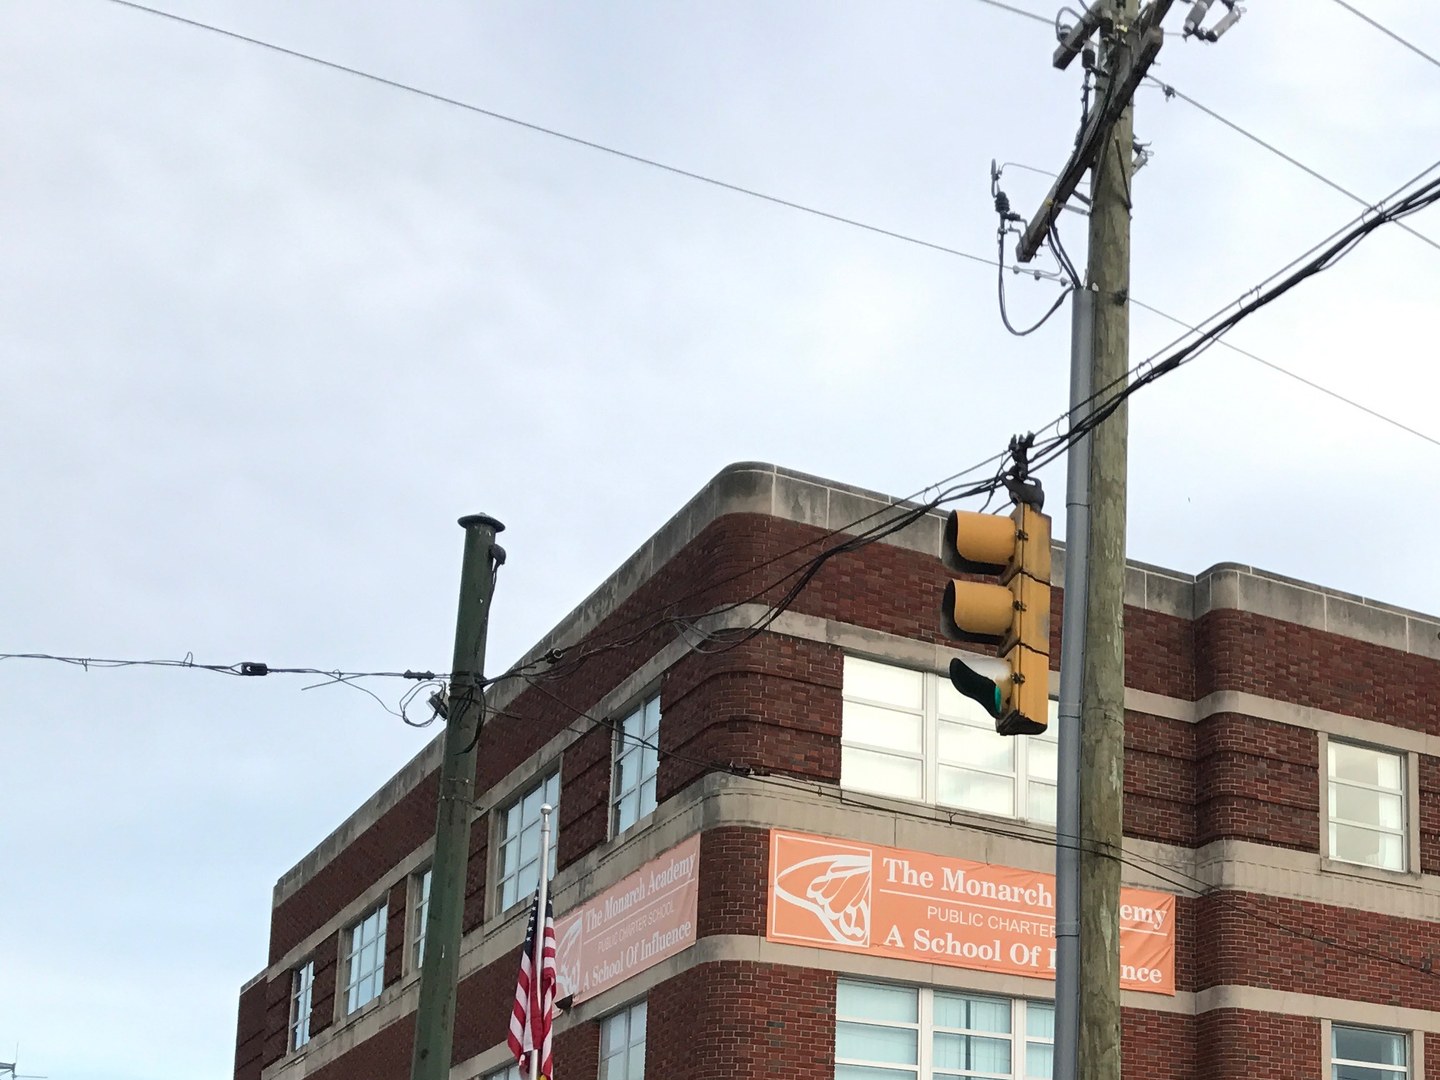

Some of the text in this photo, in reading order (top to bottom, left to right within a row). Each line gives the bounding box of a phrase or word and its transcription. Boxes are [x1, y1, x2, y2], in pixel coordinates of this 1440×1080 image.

[586, 853, 696, 933] The Monarch Academy
[883, 857, 1053, 908] The Monarch
[620, 915, 647, 941] CHARTER
[648, 900, 675, 926] SCHOOL
[927, 906, 983, 928] PUBLIC
[582, 920, 691, 993] A School Of Influence
[884, 928, 905, 948] A
[913, 928, 1001, 962] School
[1010, 943, 1042, 967] Of
